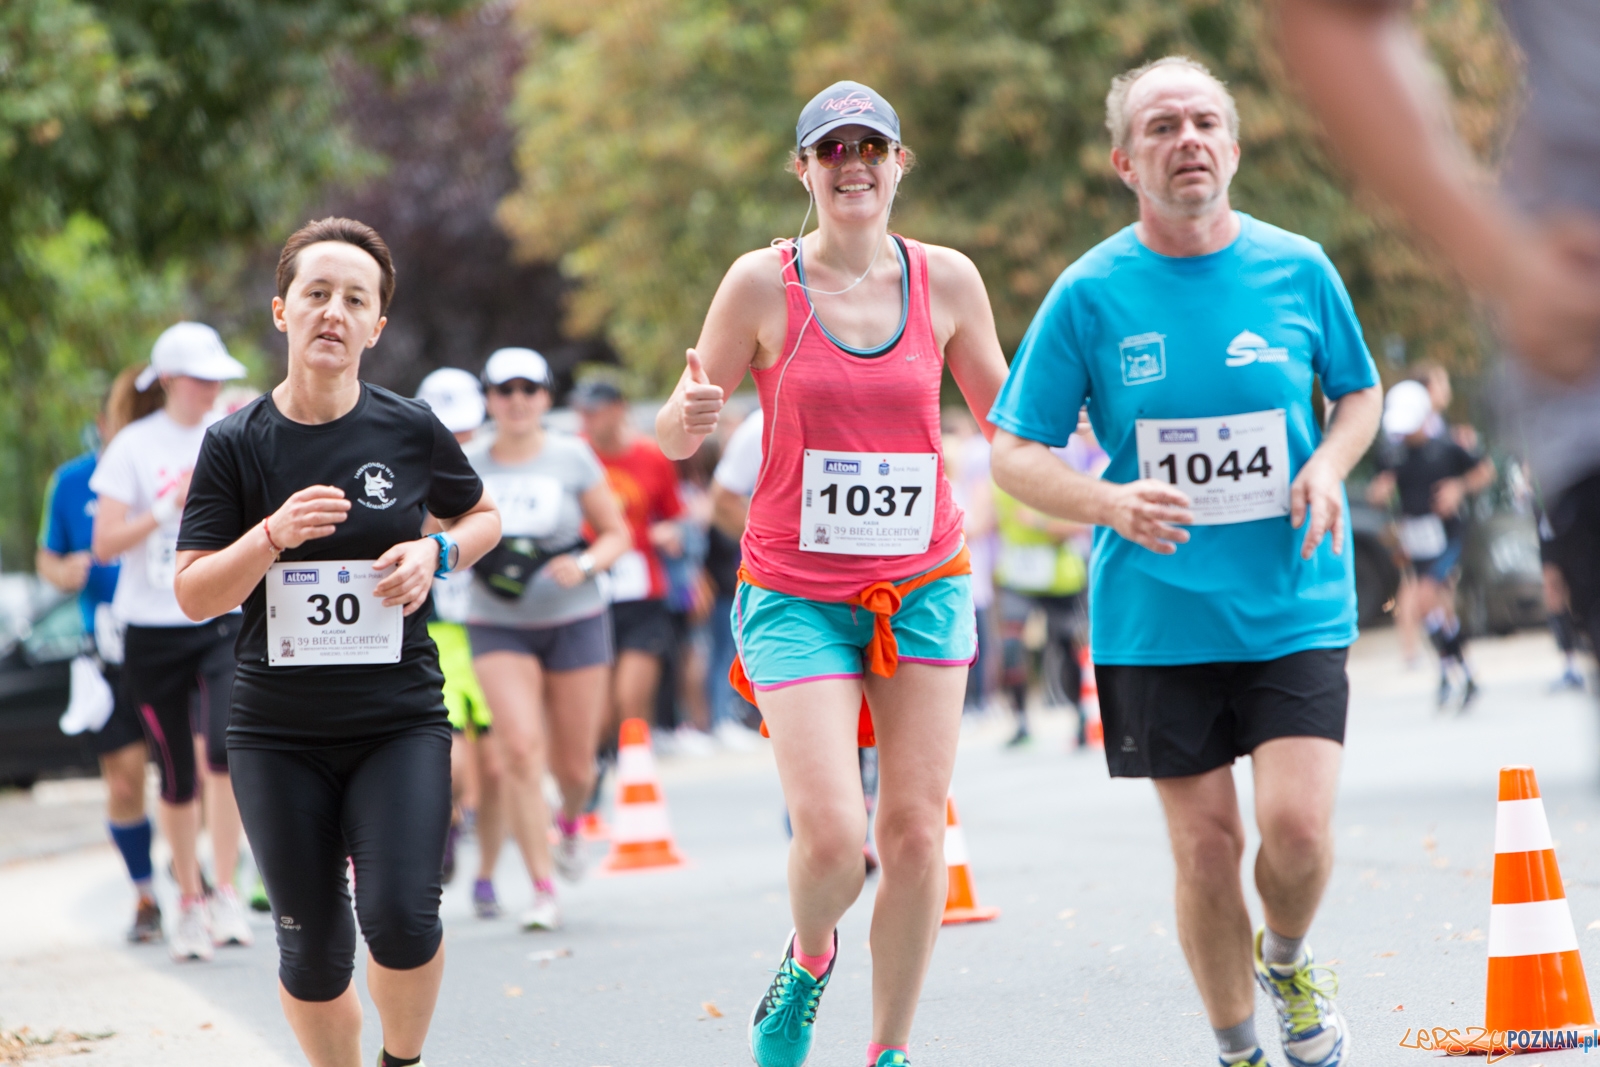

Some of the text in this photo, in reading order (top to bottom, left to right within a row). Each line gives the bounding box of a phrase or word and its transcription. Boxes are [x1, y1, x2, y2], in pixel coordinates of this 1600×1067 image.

[1159, 446, 1273, 485] 1044
[820, 483, 922, 517] 1037
[834, 526, 922, 537] 39 BIEG LECHITÓW
[306, 593, 360, 626] 30
[297, 633, 390, 646] 39 BIEG LECHITÓW
